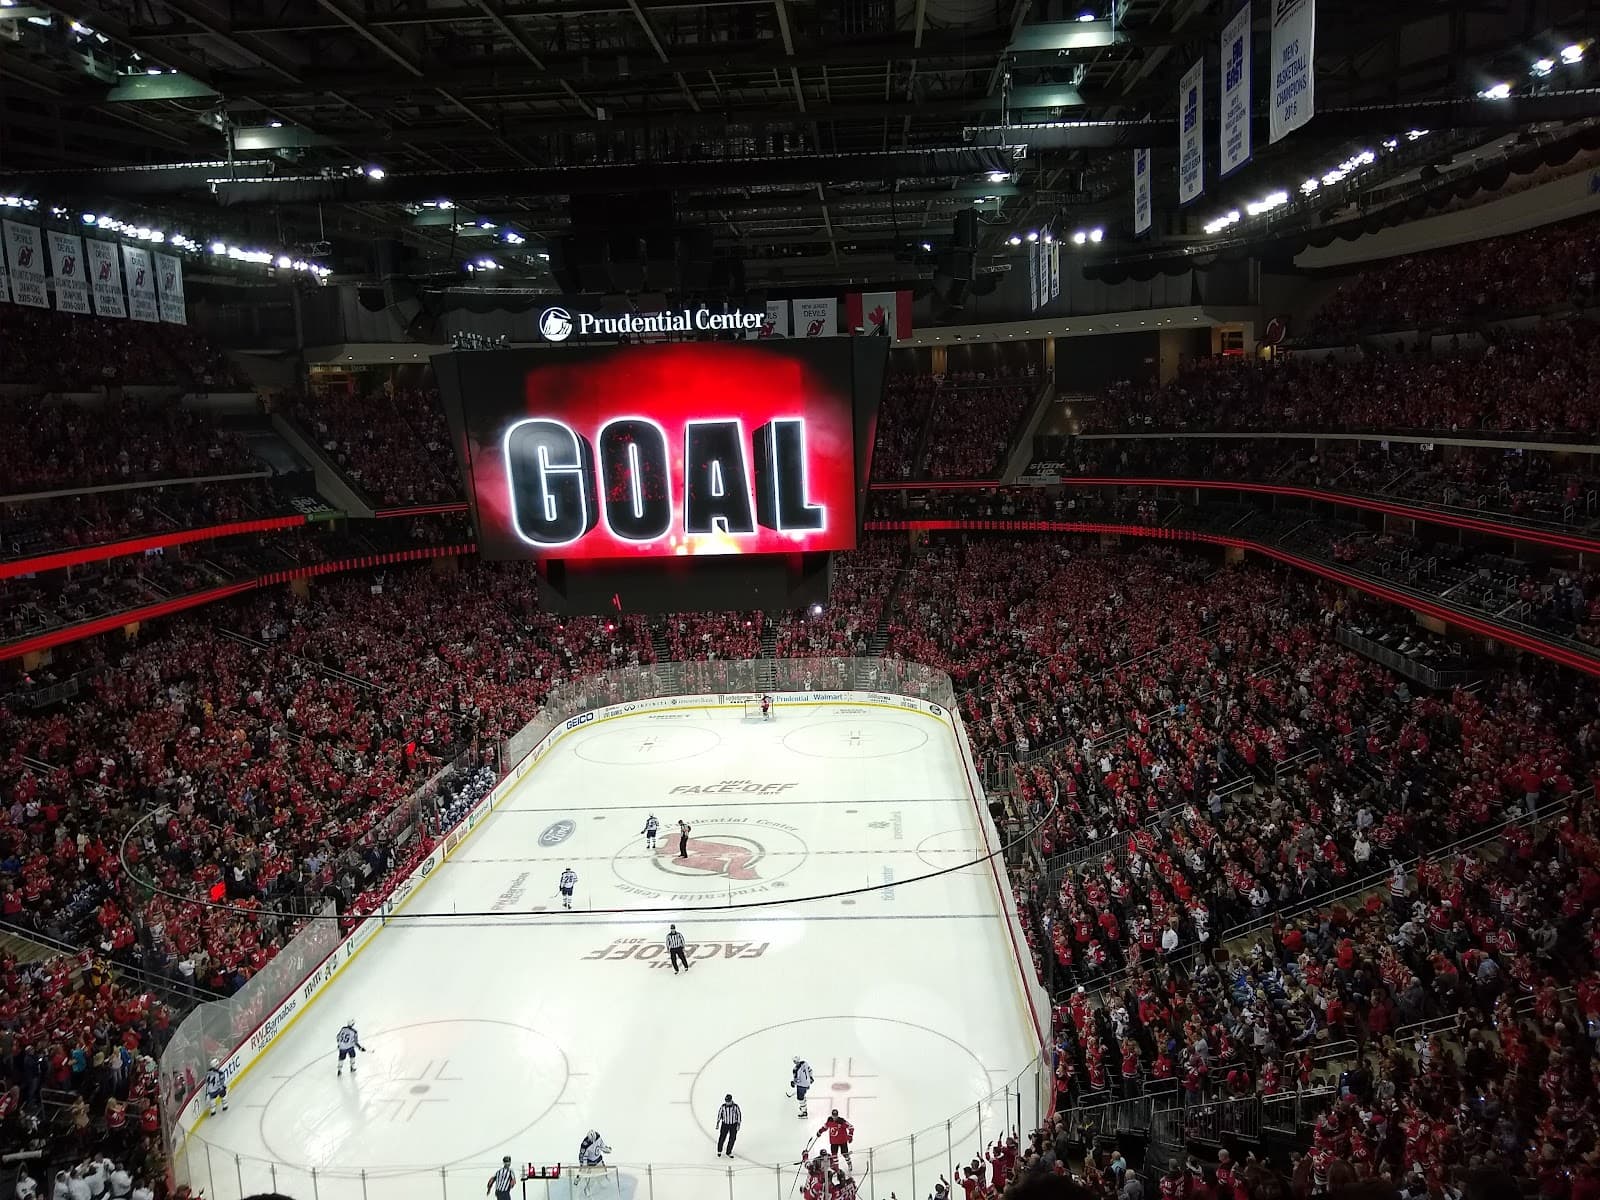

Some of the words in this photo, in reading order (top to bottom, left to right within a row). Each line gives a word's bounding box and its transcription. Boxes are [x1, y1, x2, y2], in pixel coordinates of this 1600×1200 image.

[1283, 39, 1299, 61] MEN'S
[1276, 54, 1307, 89] BASKETBALL
[1276, 74, 1307, 108] CHAMPIONS
[578, 310, 692, 335] Prudential
[695, 308, 765, 330] Center
[804, 310, 826, 318] DEVILS
[503, 415, 827, 548] GOAL
[776, 695, 809, 703] Prudential
[813, 693, 842, 701] Walmart
[566, 712, 594, 730] GEICO
[613, 937, 647, 945] 2019
[1143, 934, 1154, 944] 13
